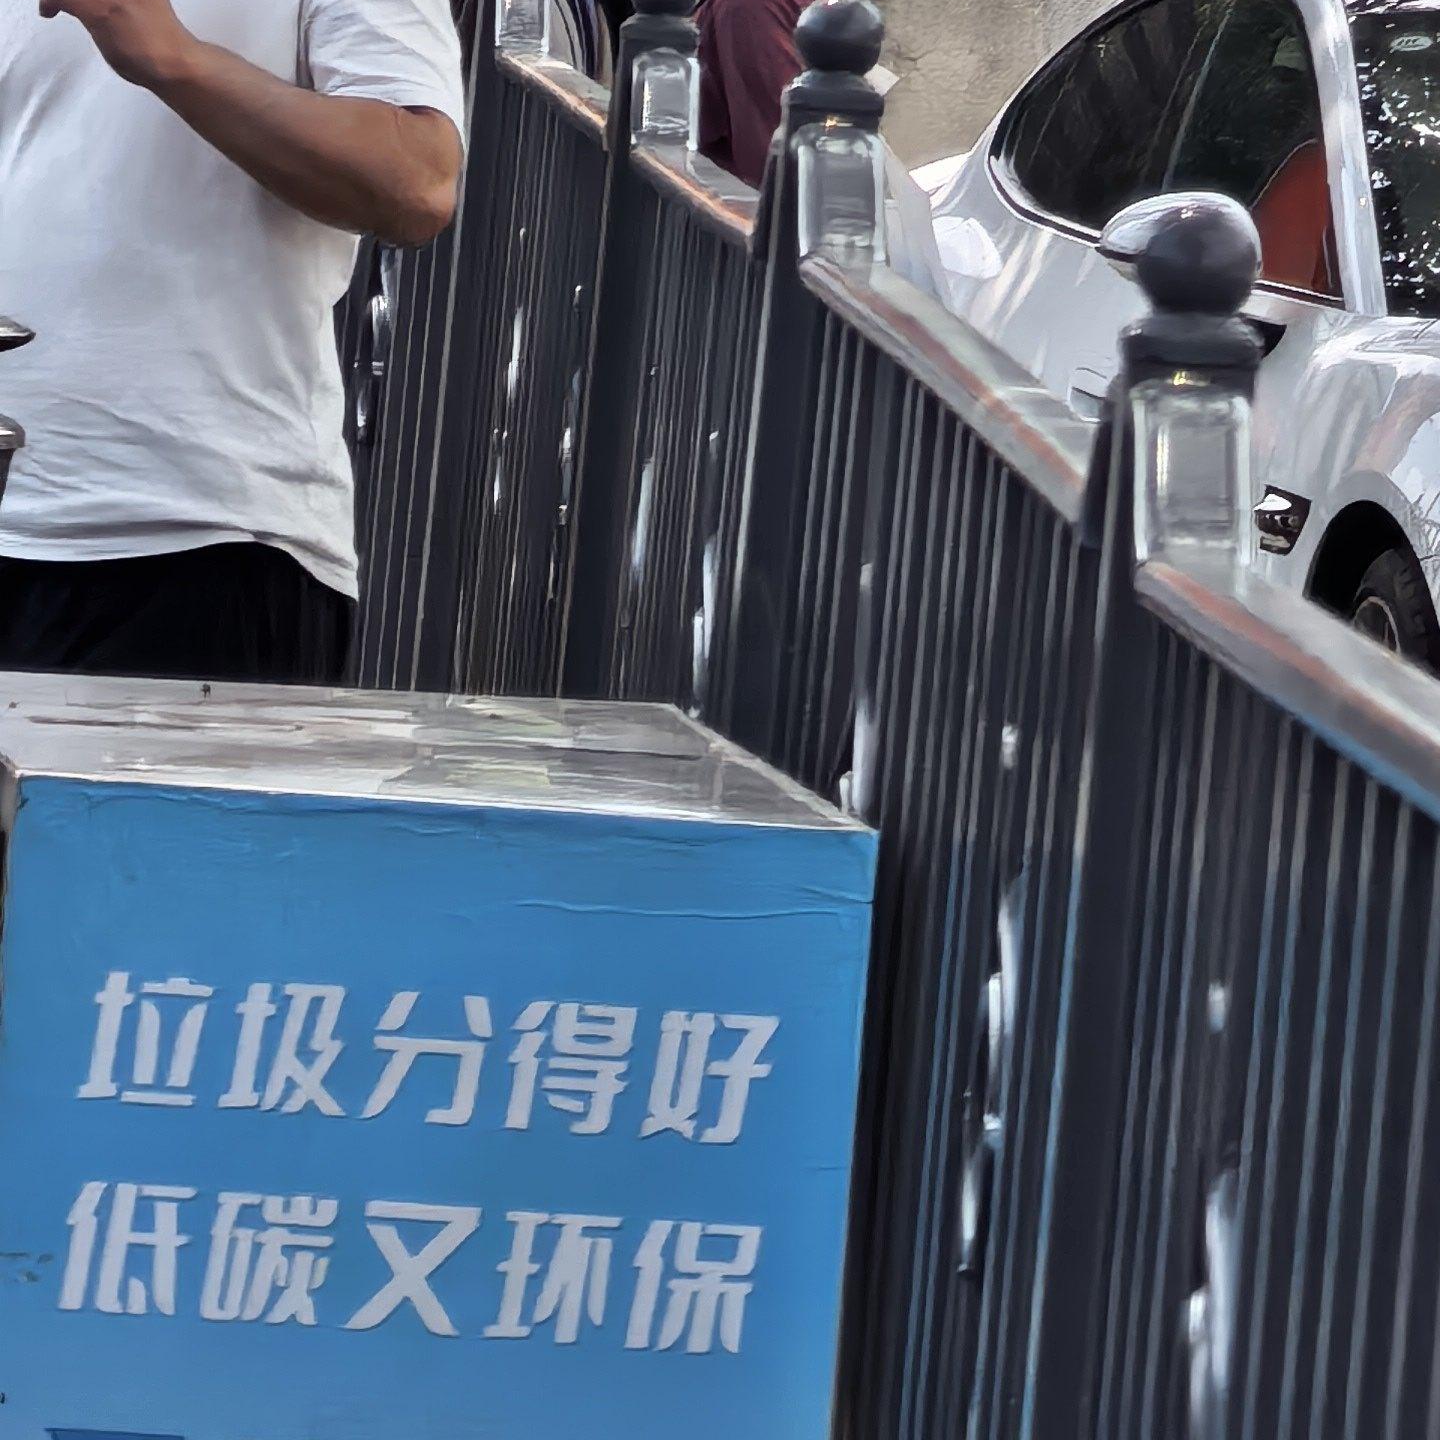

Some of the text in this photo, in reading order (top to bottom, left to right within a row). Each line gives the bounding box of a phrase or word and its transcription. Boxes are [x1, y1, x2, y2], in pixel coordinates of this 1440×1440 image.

[76, 970, 780, 1146] 垃圾分得好
[58, 1179, 764, 1355] 低碳又环保
